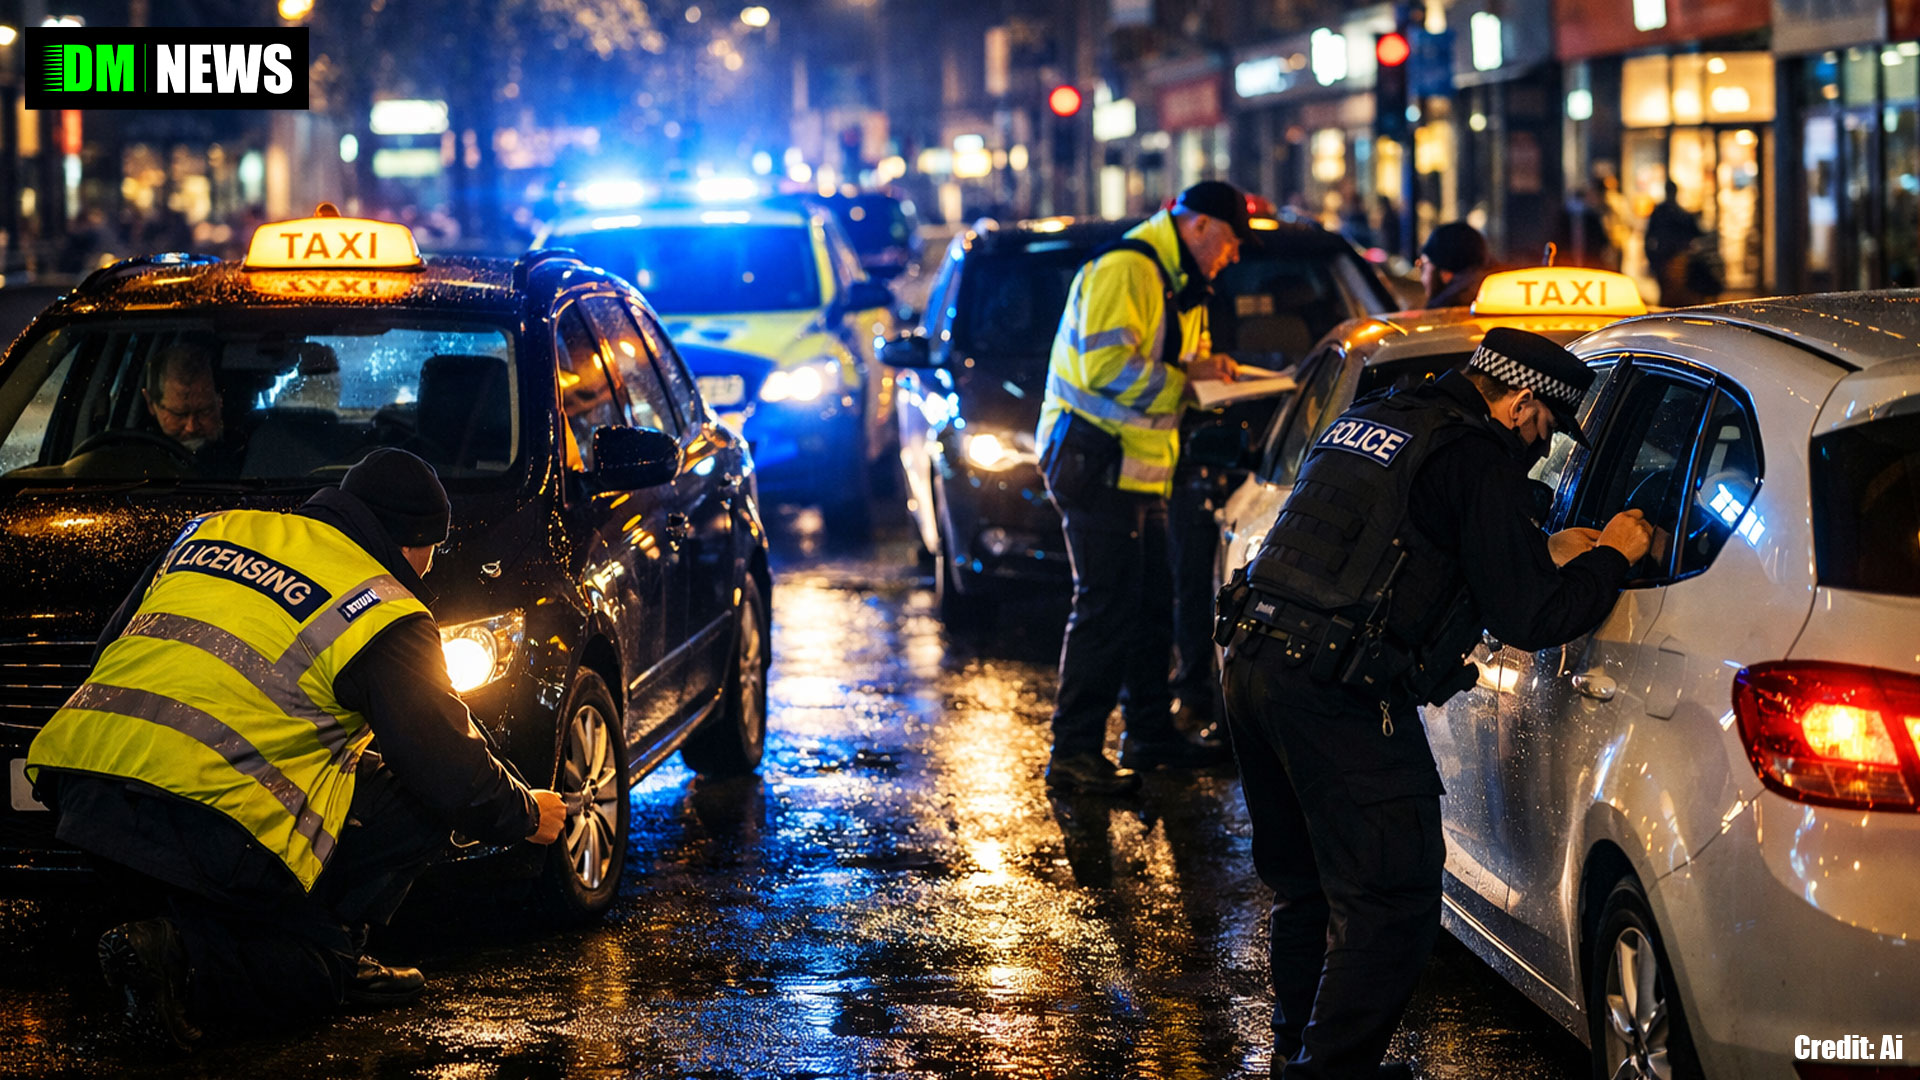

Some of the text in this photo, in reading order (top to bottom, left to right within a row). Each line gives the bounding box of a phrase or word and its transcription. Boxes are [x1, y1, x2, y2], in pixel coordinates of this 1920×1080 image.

[280, 232, 377, 259] TAXI
[1516, 281, 1607, 306] TAXI
[1321, 421, 1404, 461] POLICE
[175, 544, 312, 606] LICENSING
